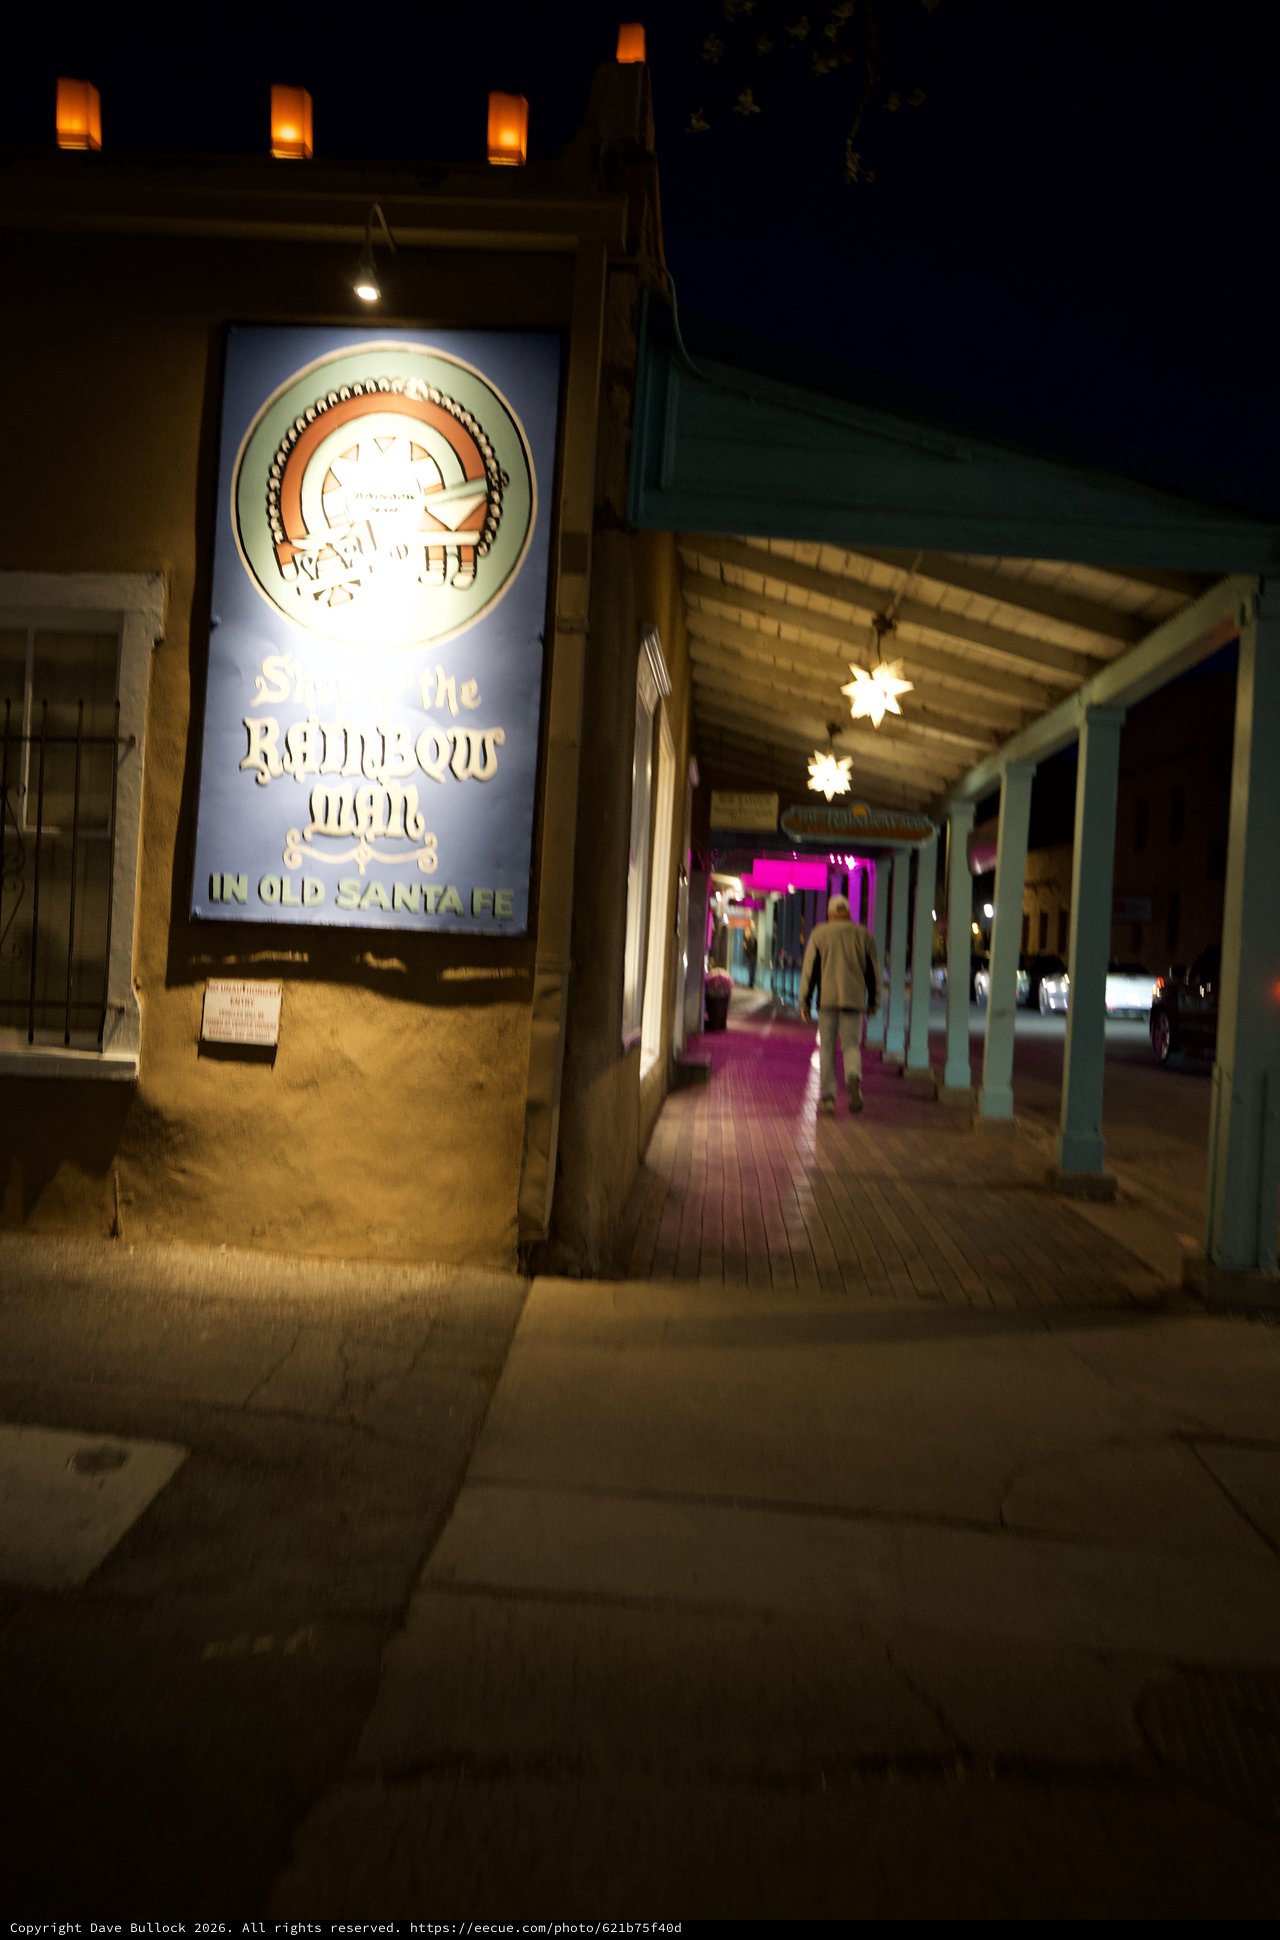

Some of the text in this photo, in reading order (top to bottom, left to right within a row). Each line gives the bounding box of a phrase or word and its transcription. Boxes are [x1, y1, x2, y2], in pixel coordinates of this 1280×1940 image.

[208, 872, 515, 919] IN OLD SANTA FE
